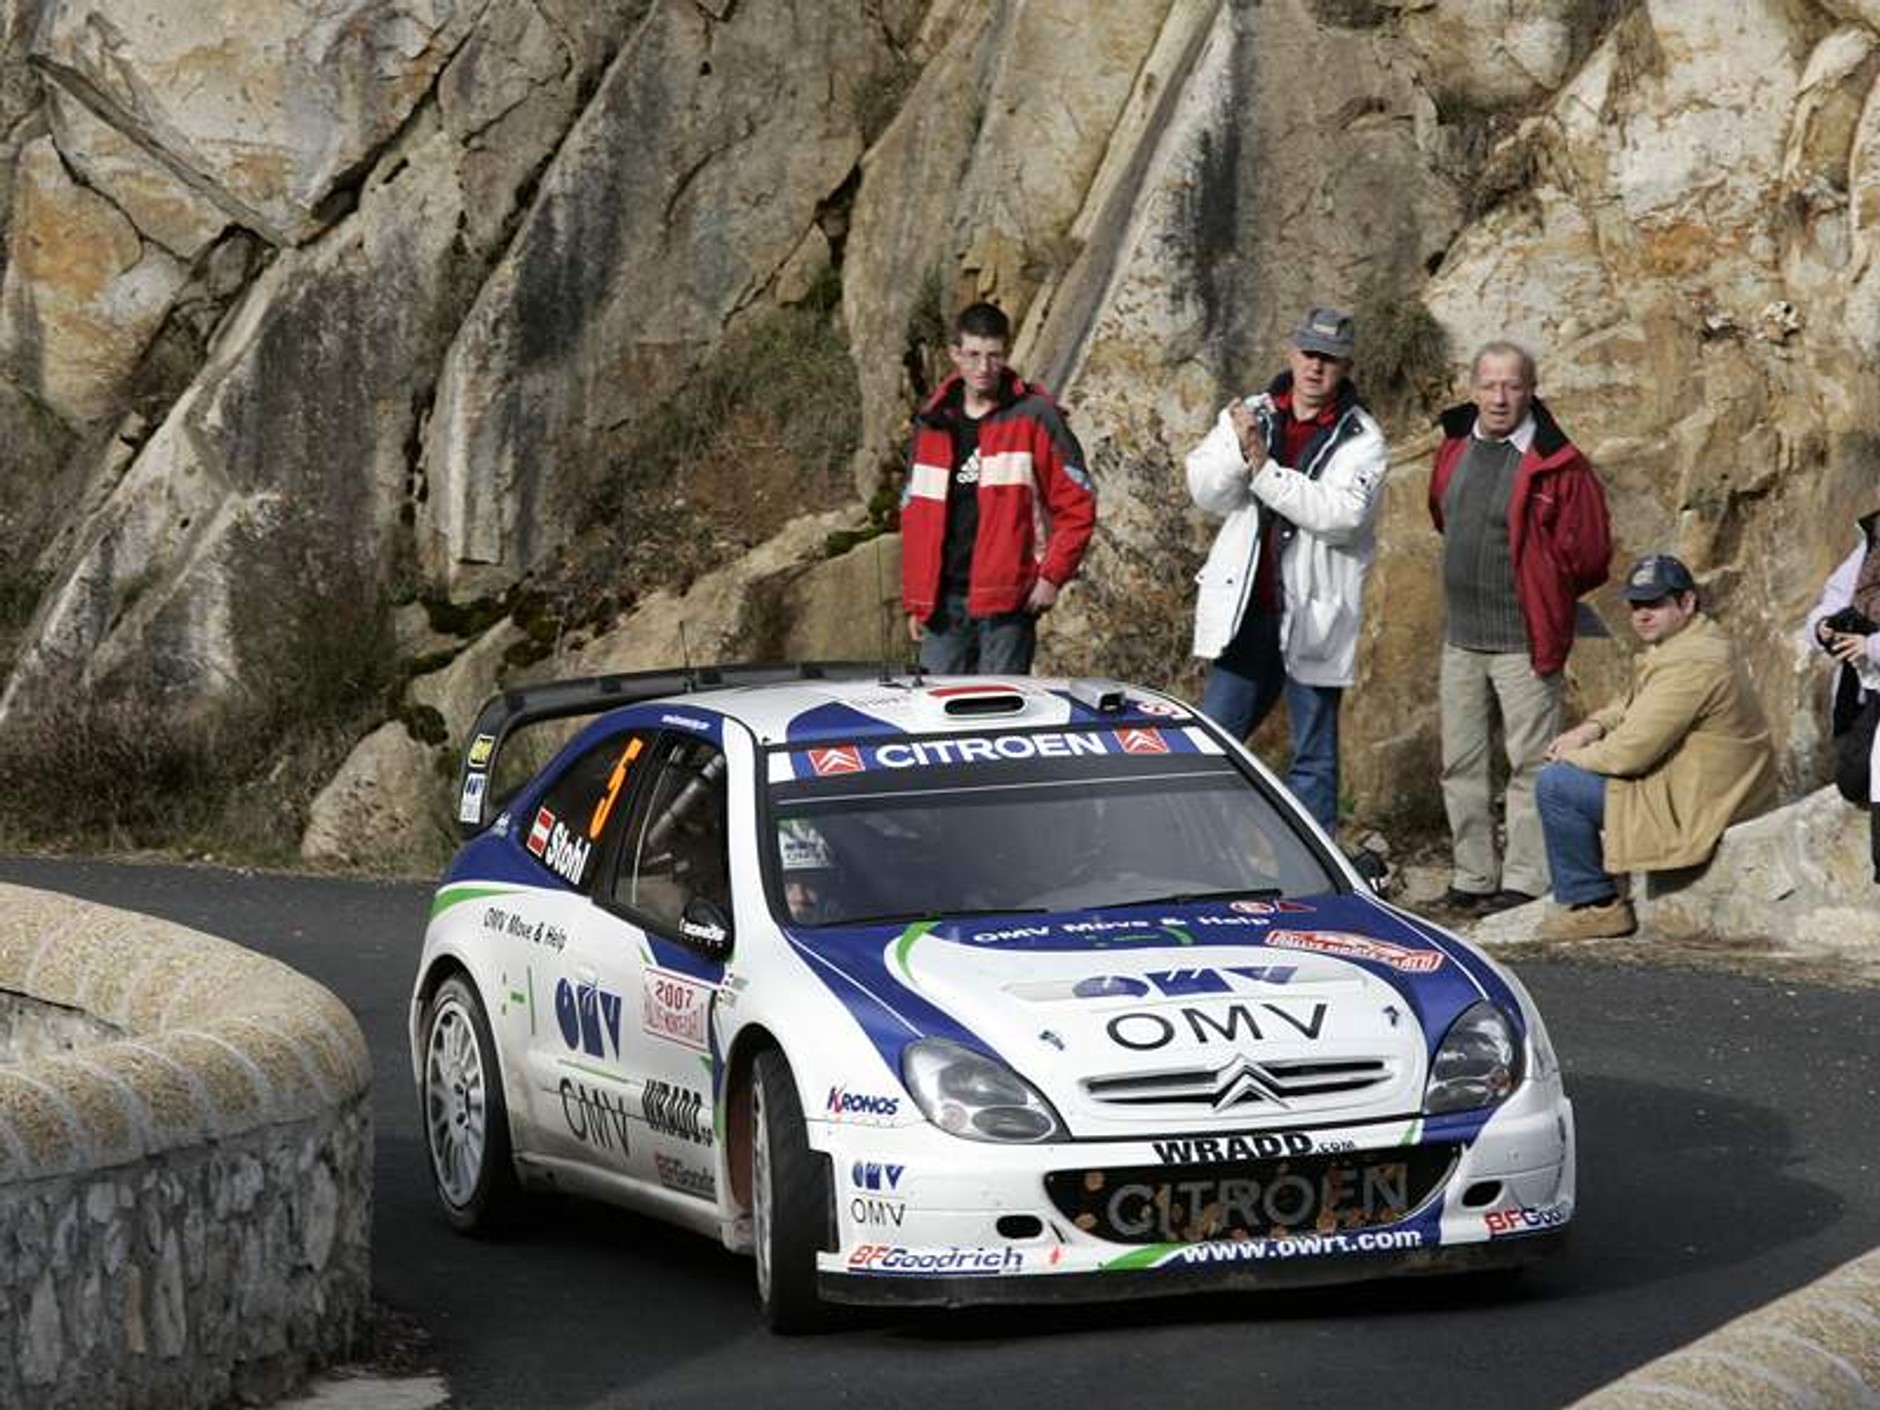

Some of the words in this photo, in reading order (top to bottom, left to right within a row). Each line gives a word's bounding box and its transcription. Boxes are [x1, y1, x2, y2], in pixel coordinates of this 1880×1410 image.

[876, 732, 1108, 768] CITROEN
[590, 737, 643, 838] 5
[545, 821, 591, 885] Stohl
[534, 922, 544, 943] &
[973, 926, 1050, 942] OMV
[1063, 920, 1149, 934] Move
[655, 980, 695, 1011] 2007
[1106, 1003, 1327, 1051] OMV
[560, 1077, 630, 1157] OMV
[827, 1087, 899, 1115] KRONOS
[851, 1198, 905, 1228] OMV
[849, 1245, 1024, 1268] BFGoodrich
[1182, 1229, 1422, 1264] www.owrt.com
